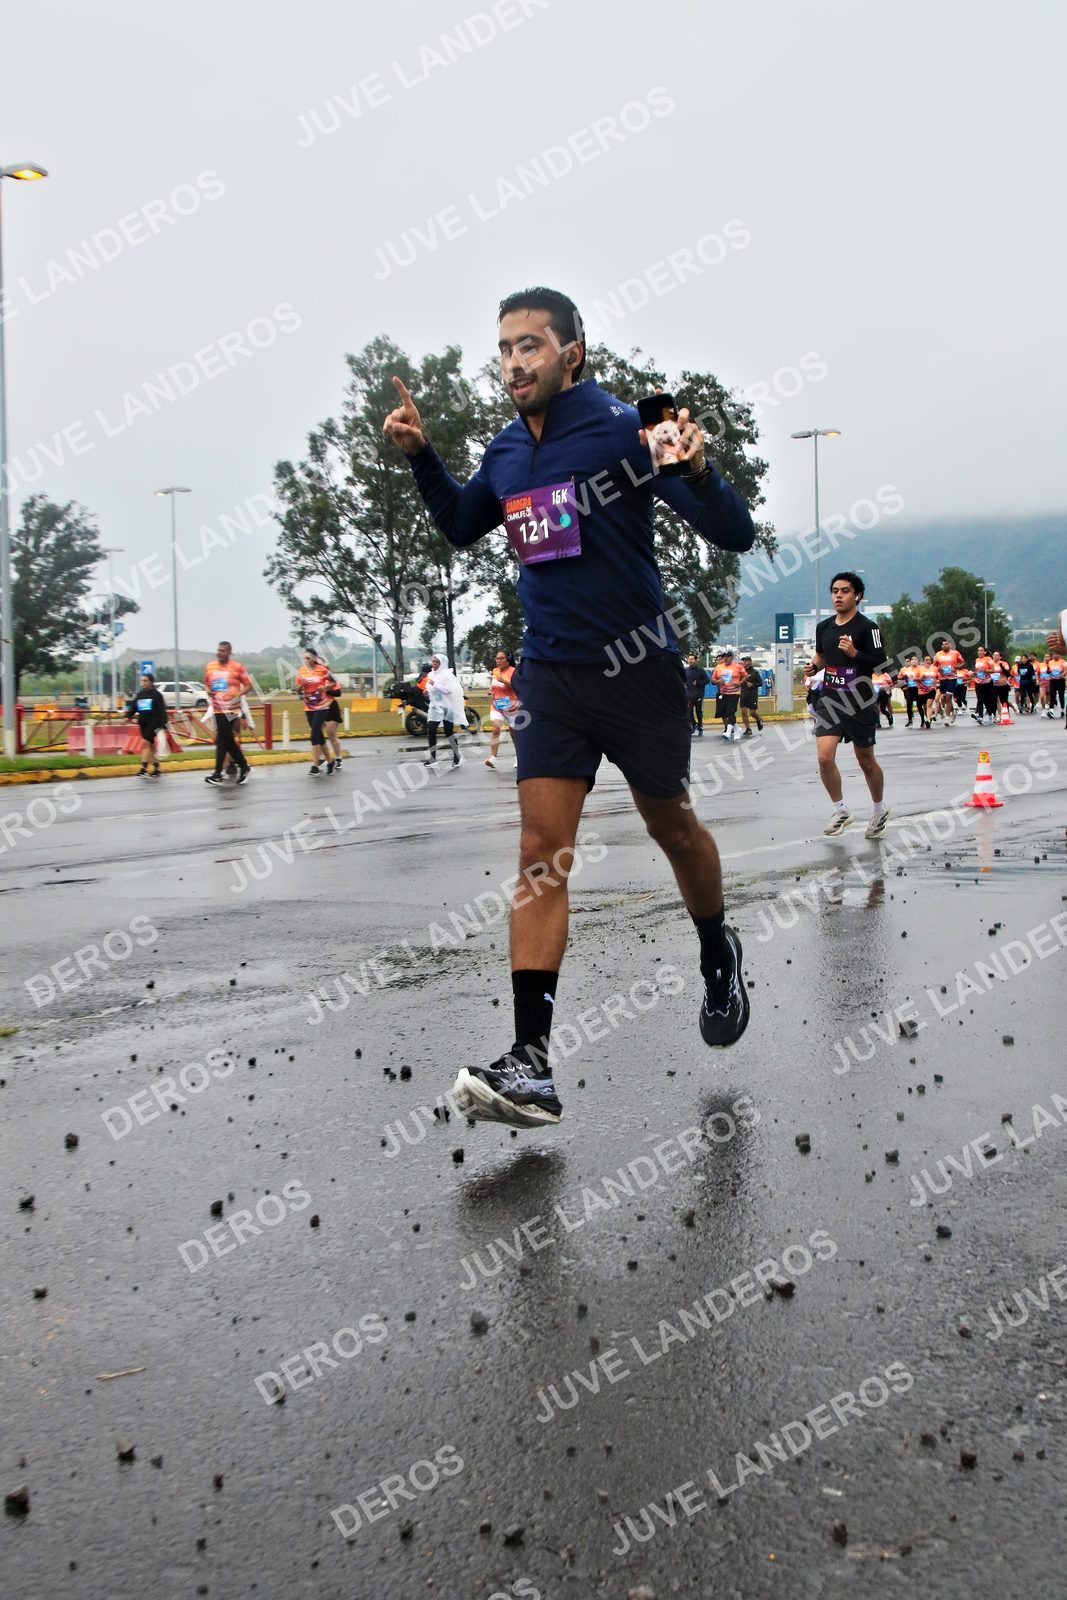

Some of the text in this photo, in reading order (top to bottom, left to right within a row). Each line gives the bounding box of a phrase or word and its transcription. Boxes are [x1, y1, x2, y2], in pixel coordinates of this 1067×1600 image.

[519, 518, 549, 544] 121
[779, 626, 789, 639] E
[830, 676, 845, 685] 743
